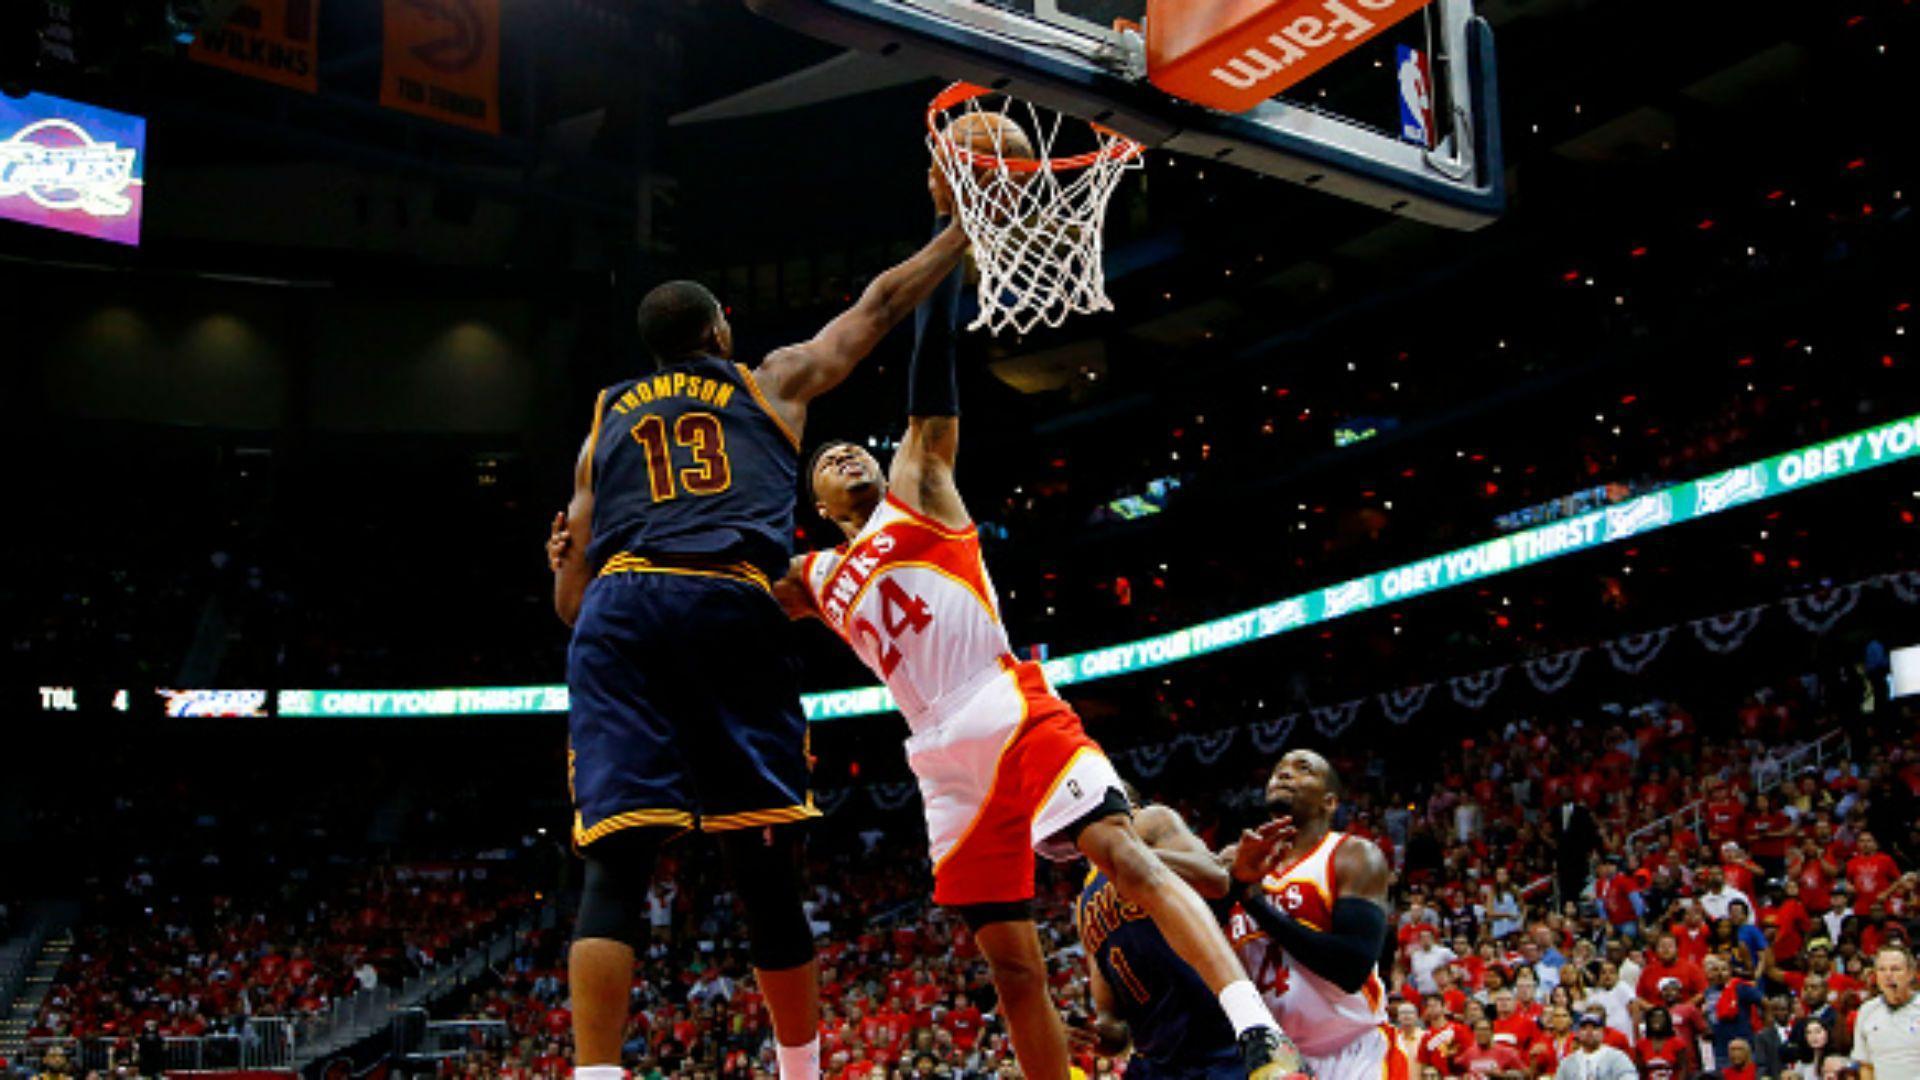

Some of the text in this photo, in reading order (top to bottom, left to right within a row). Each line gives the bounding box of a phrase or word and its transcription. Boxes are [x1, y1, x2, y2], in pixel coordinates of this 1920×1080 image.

[202, 28, 309, 76] WILKINS
[612, 372, 735, 414] THOMPSON
[630, 411, 732, 503] 13
[1777, 435, 1863, 486] OBEY
[1381, 557, 1442, 598] OBEY
[1444, 537, 1511, 580] YOUR
[1512, 512, 1603, 562] THIRST
[853, 576, 933, 681] 24
[1081, 645, 1134, 676] OBEY
[112, 689, 129, 711] 4
